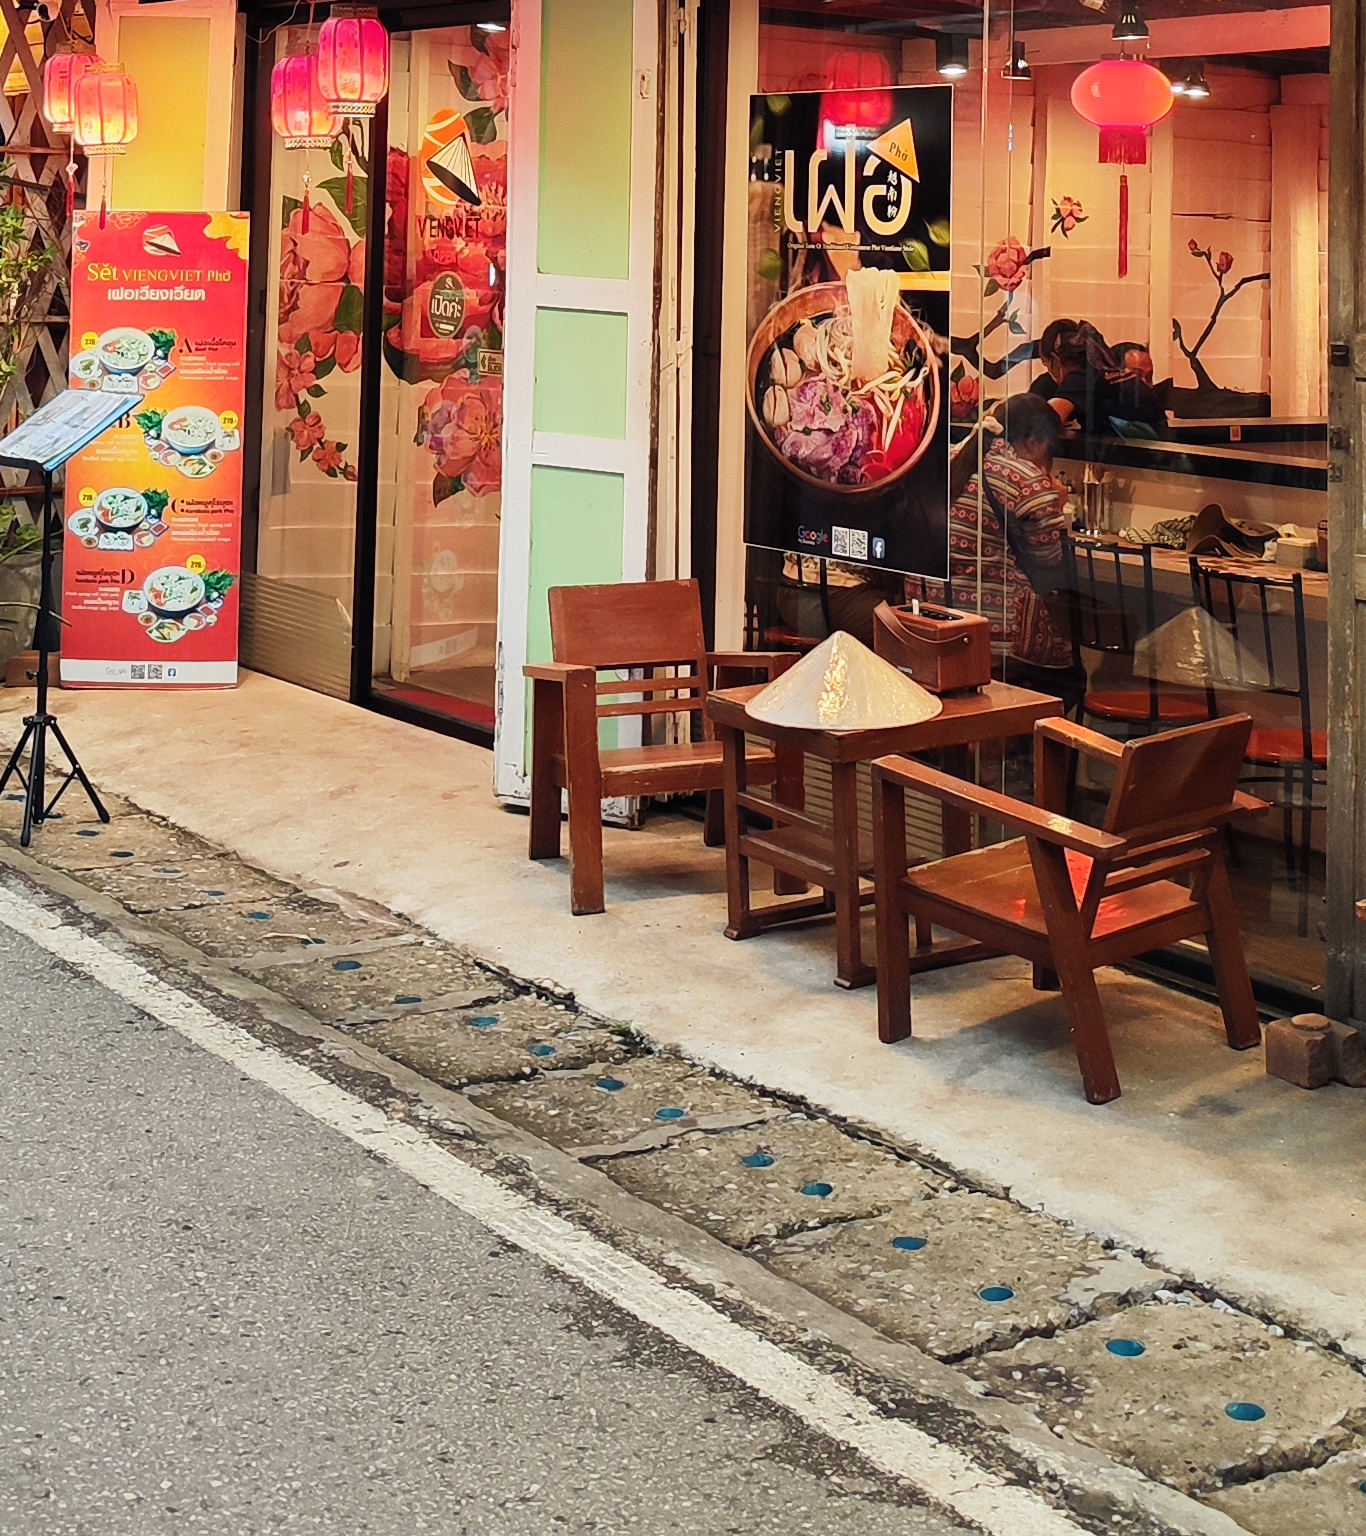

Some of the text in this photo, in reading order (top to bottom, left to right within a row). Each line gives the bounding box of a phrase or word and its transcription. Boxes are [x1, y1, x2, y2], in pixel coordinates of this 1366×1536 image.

[122, 268, 203, 282] VIENGVIET
[431, 295, 463, 318] เปิดค่ะ
[121, 568, 135, 585] D
